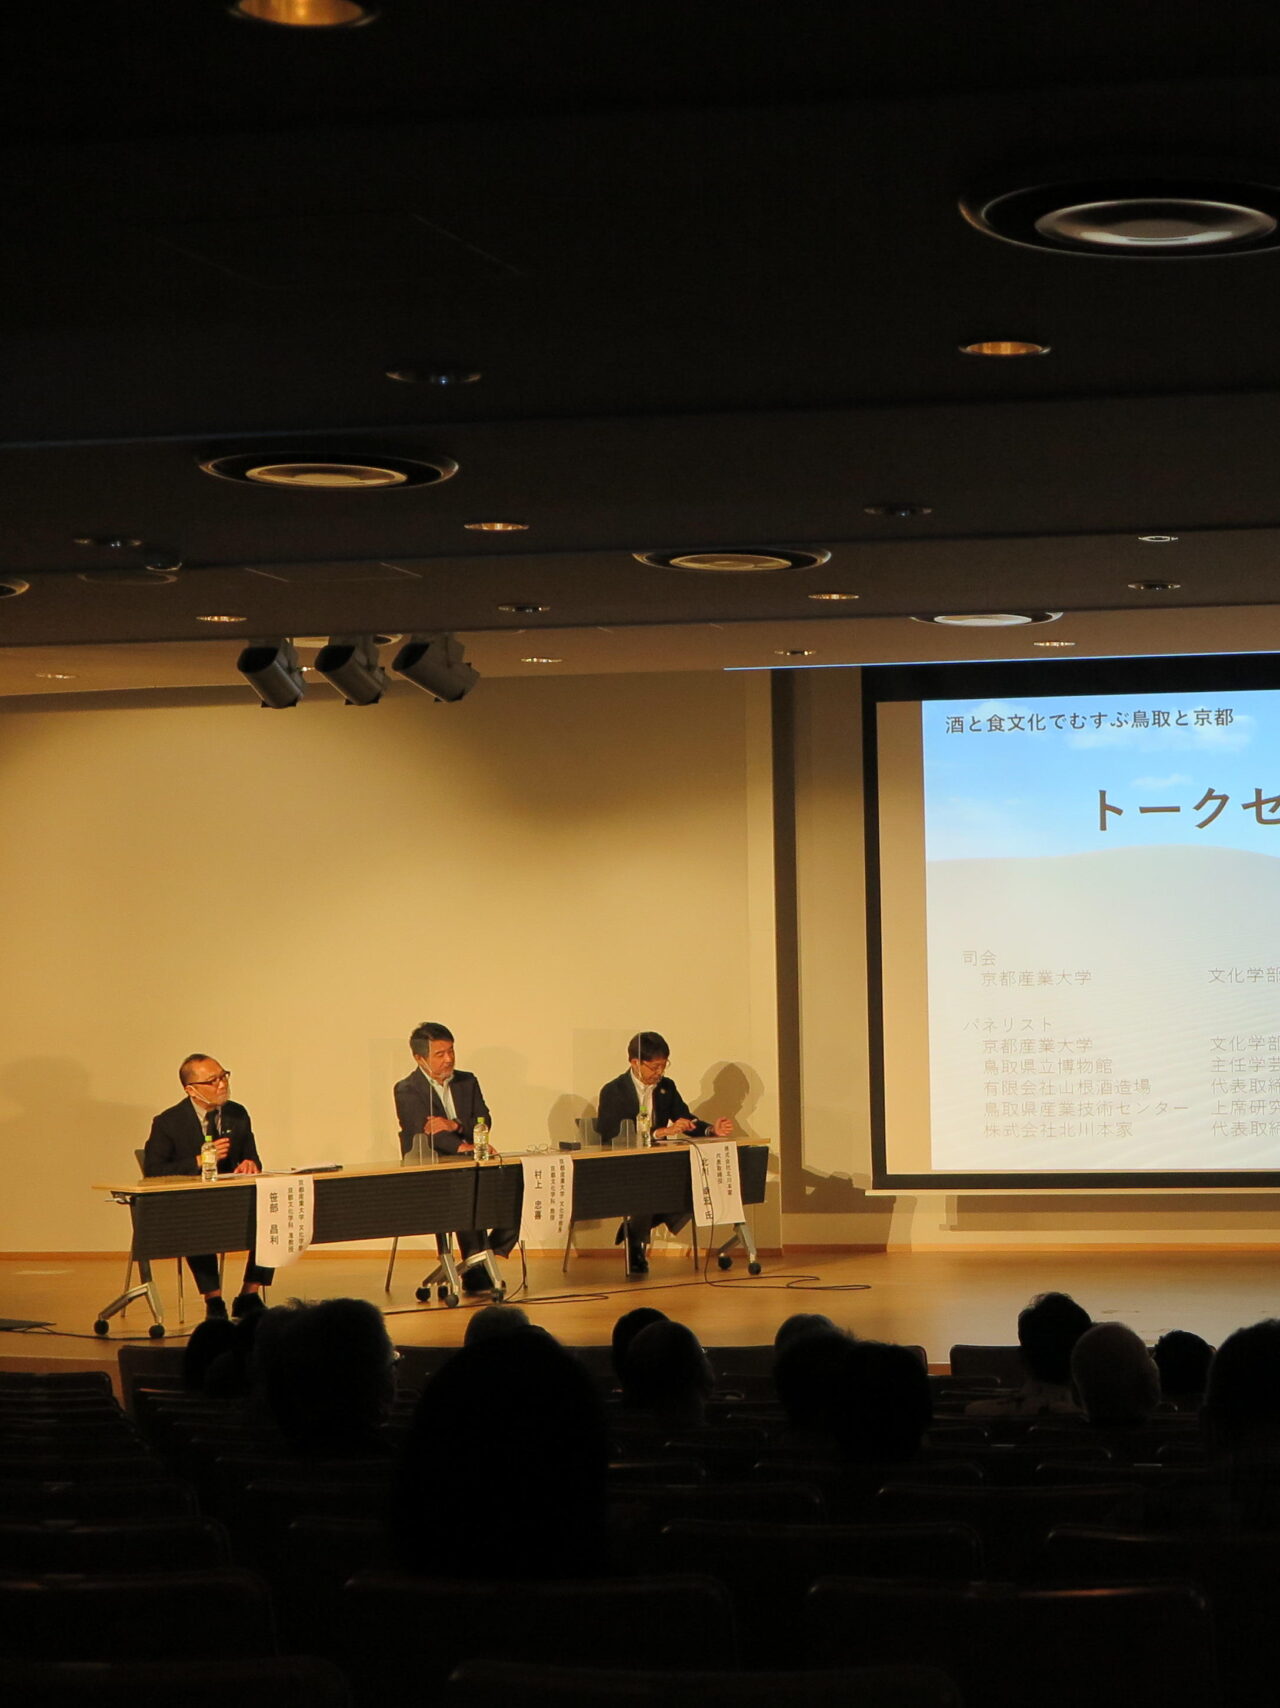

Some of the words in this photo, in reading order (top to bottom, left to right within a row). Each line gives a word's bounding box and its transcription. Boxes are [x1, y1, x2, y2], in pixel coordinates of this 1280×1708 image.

[945, 706, 1235, 734] 酒と食文化でむすぶ鳥取と京都
[962, 950, 996, 967] 司会
[981, 969, 1092, 986] 京都産業大学
[963, 1017, 1053, 1033] パネリスト
[982, 1037, 1093, 1055] 京都産業大学
[983, 1058, 1113, 1075] 鳥取県立博物館
[984, 1079, 1151, 1096] 有限会社山根酒造場
[984, 1100, 1189, 1117] 鳥取県産業技術センター
[984, 1121, 1133, 1138] 株式会社北川本家
[535, 1169, 542, 1189] 村上
